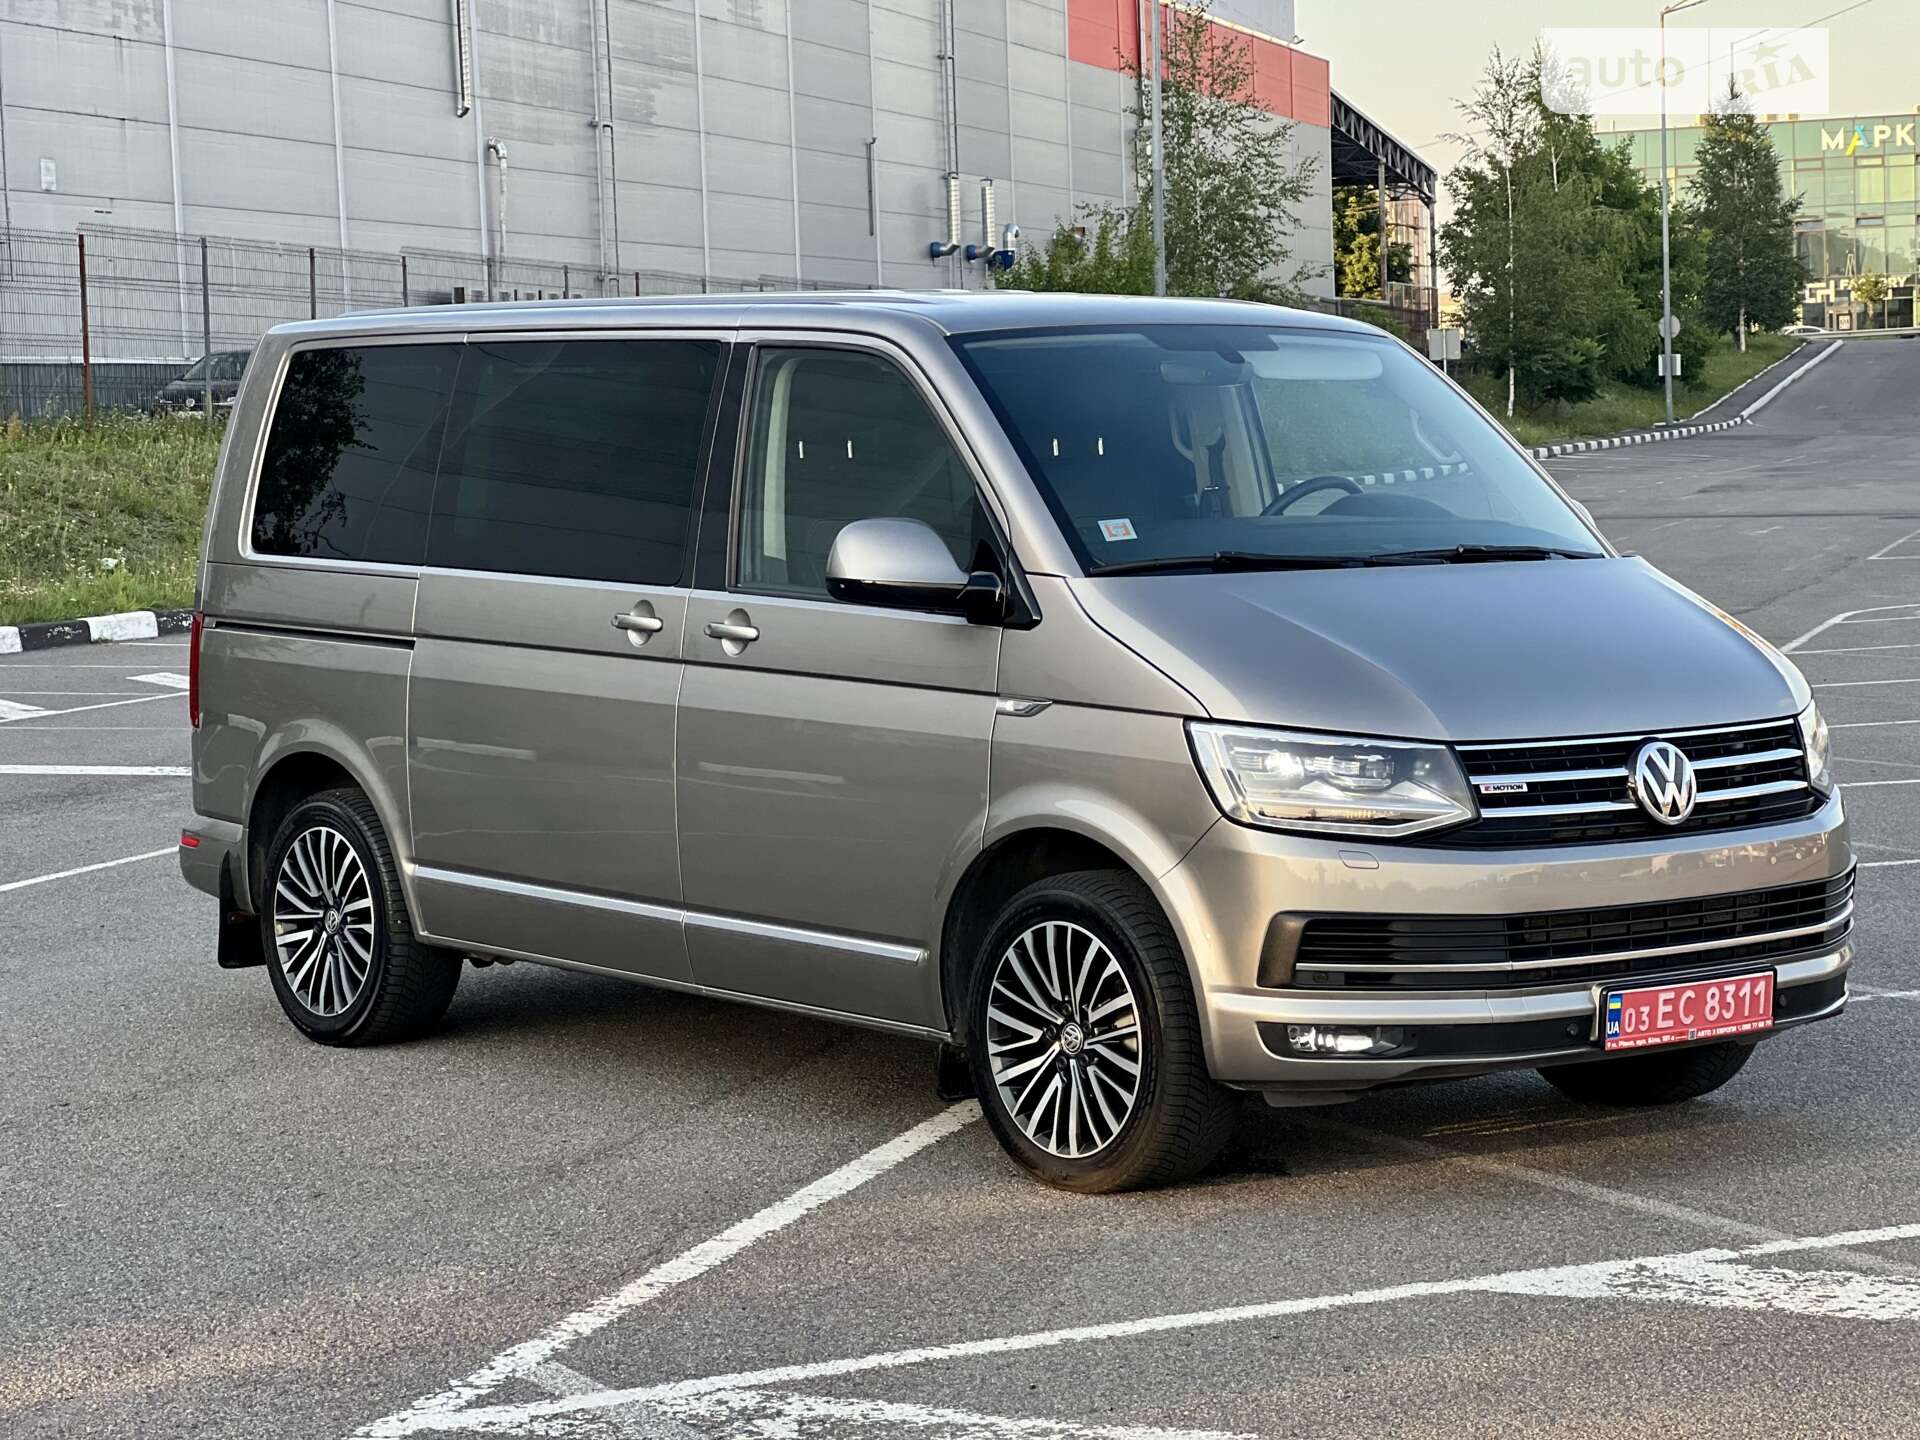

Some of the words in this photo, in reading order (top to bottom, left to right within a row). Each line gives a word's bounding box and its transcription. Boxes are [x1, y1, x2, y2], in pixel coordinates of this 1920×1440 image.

[1624, 1006, 1651, 1033] 03
[1657, 989, 1696, 1029] EC
[1704, 980, 1766, 1022] 8311
[1607, 1021, 1620, 1035] UA
